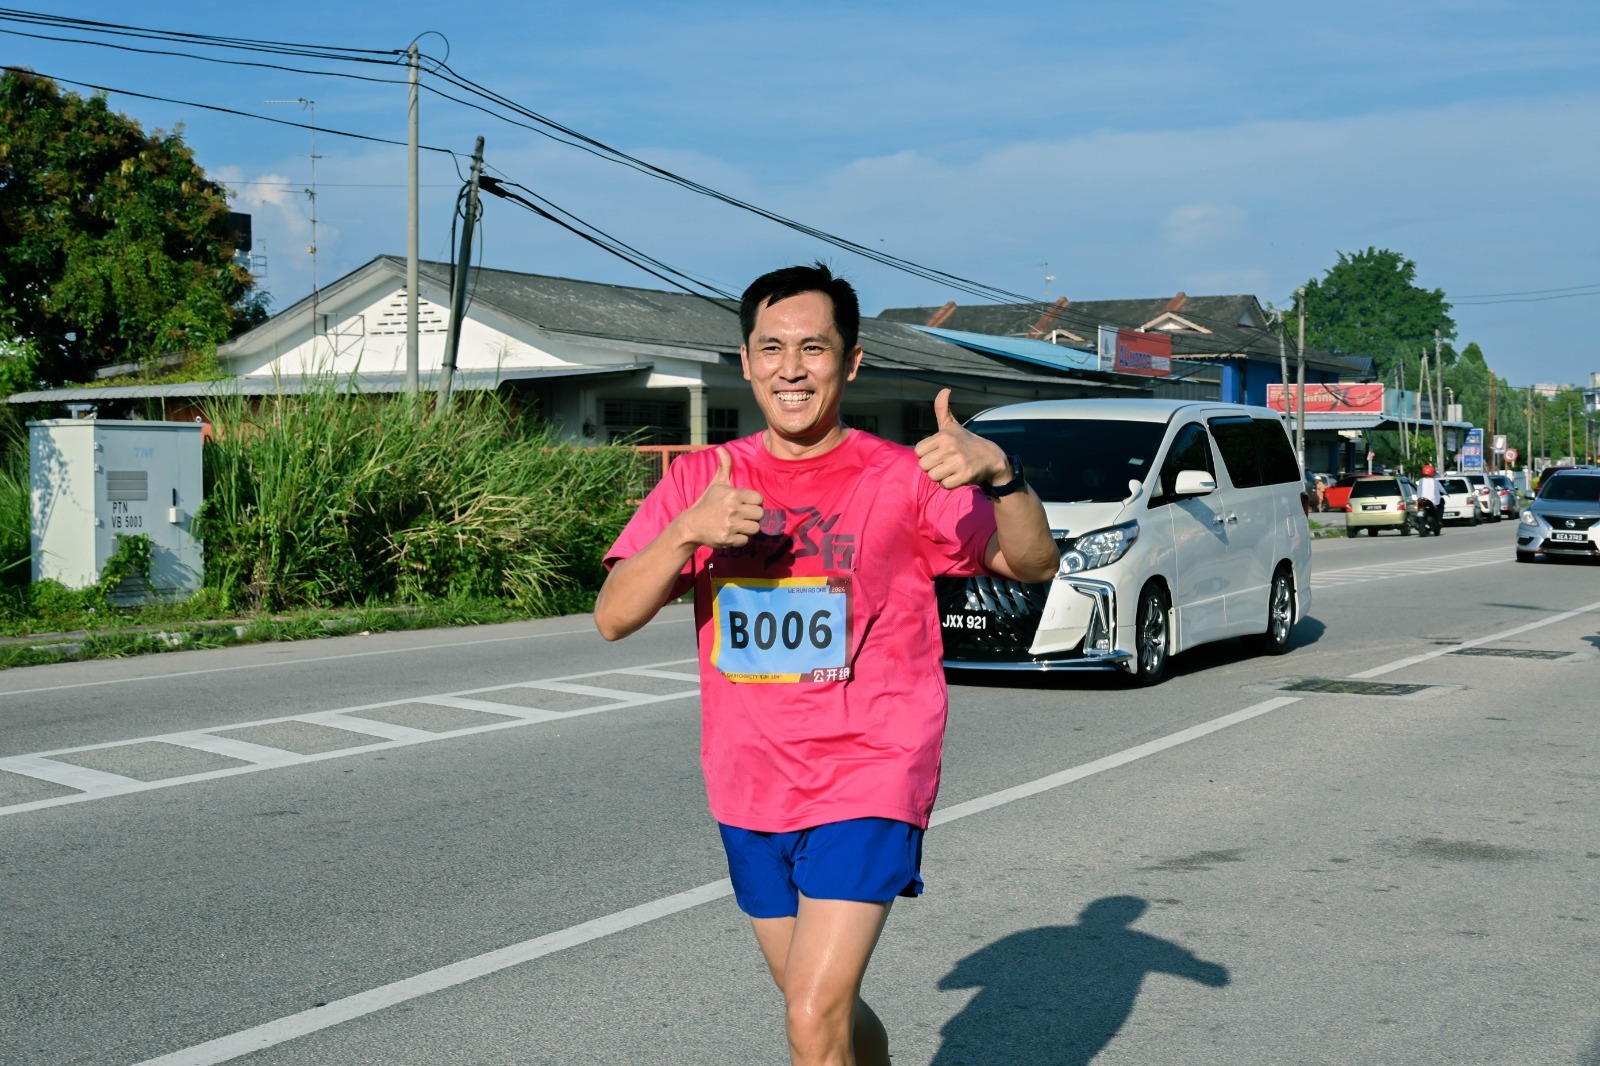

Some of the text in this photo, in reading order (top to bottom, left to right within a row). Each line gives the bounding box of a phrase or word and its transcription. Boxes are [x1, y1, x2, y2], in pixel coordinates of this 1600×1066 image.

[112, 501, 128, 514] PTN
[111, 515, 142, 528] VB 5003
[729, 609, 832, 650] B006
[942, 614, 987, 630] JXX 921
[813, 667, 850, 682] 公开组
